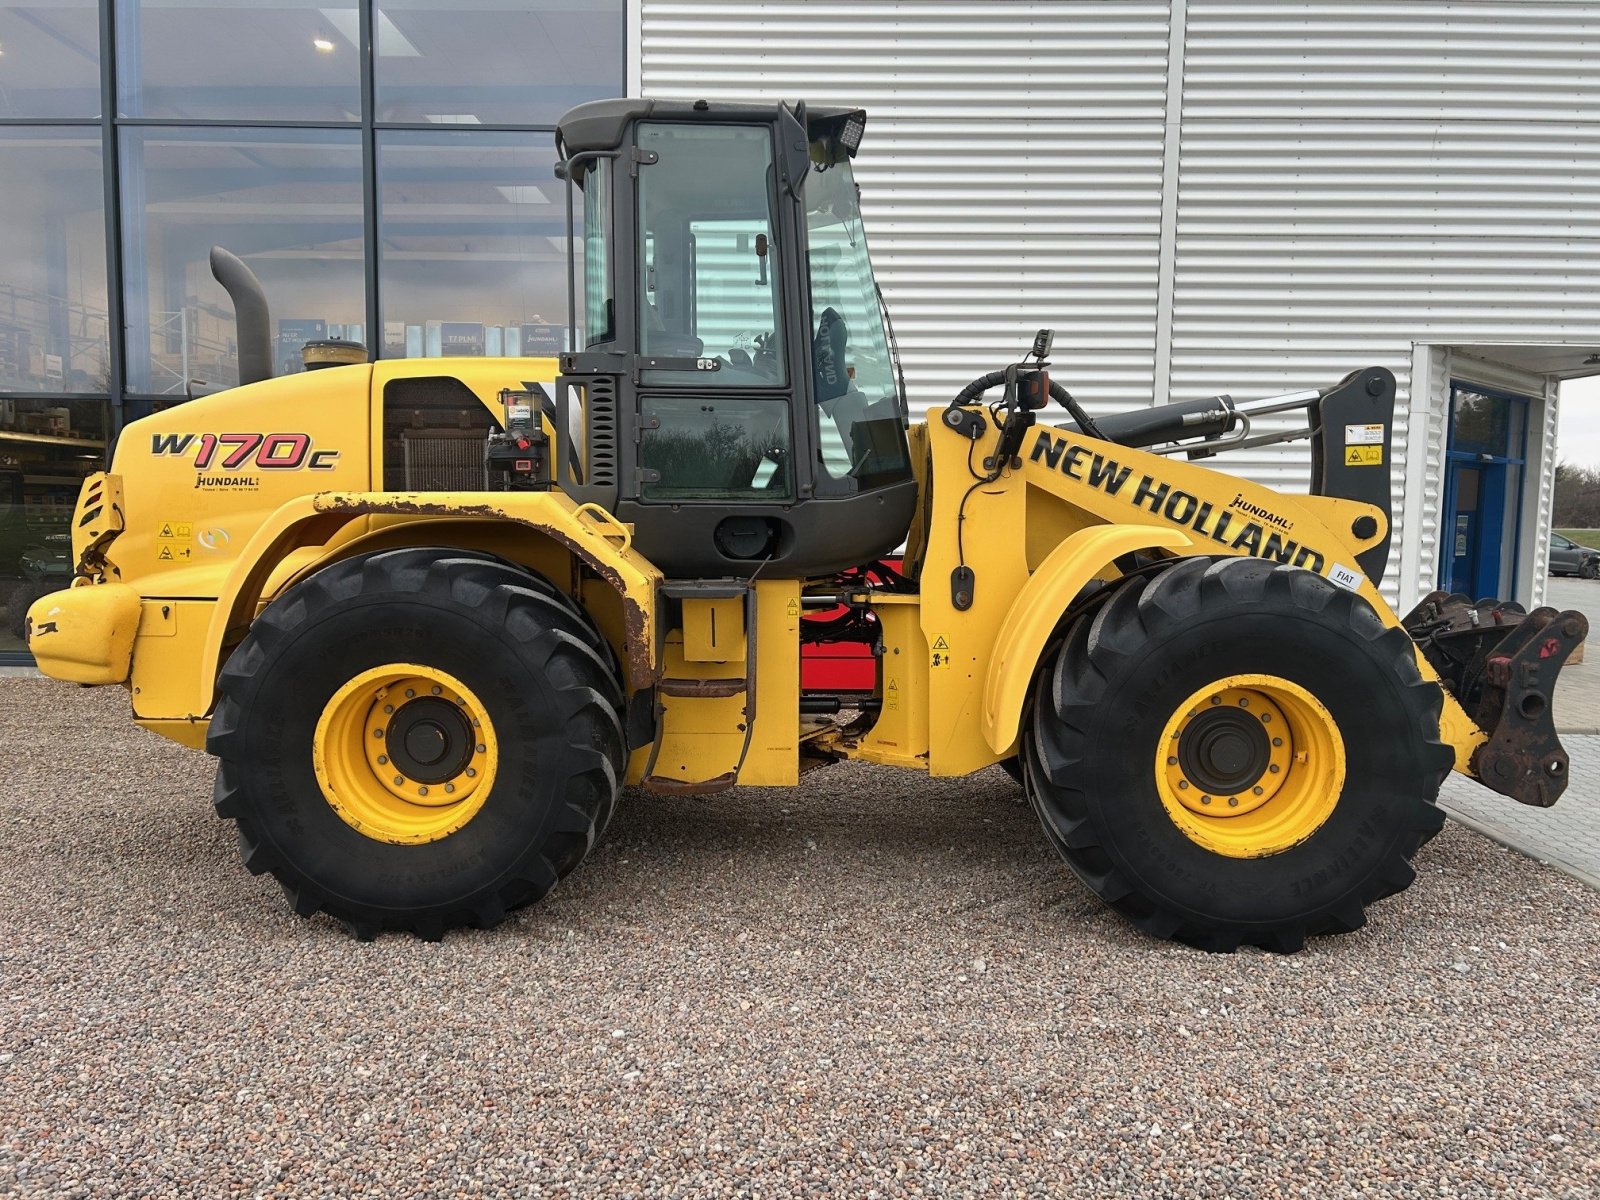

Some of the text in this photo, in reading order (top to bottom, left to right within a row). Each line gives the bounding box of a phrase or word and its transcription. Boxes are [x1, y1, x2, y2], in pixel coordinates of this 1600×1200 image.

[1030, 430, 1325, 573] NEW HOLLAND
[1336, 570, 1355, 584] FIAT
